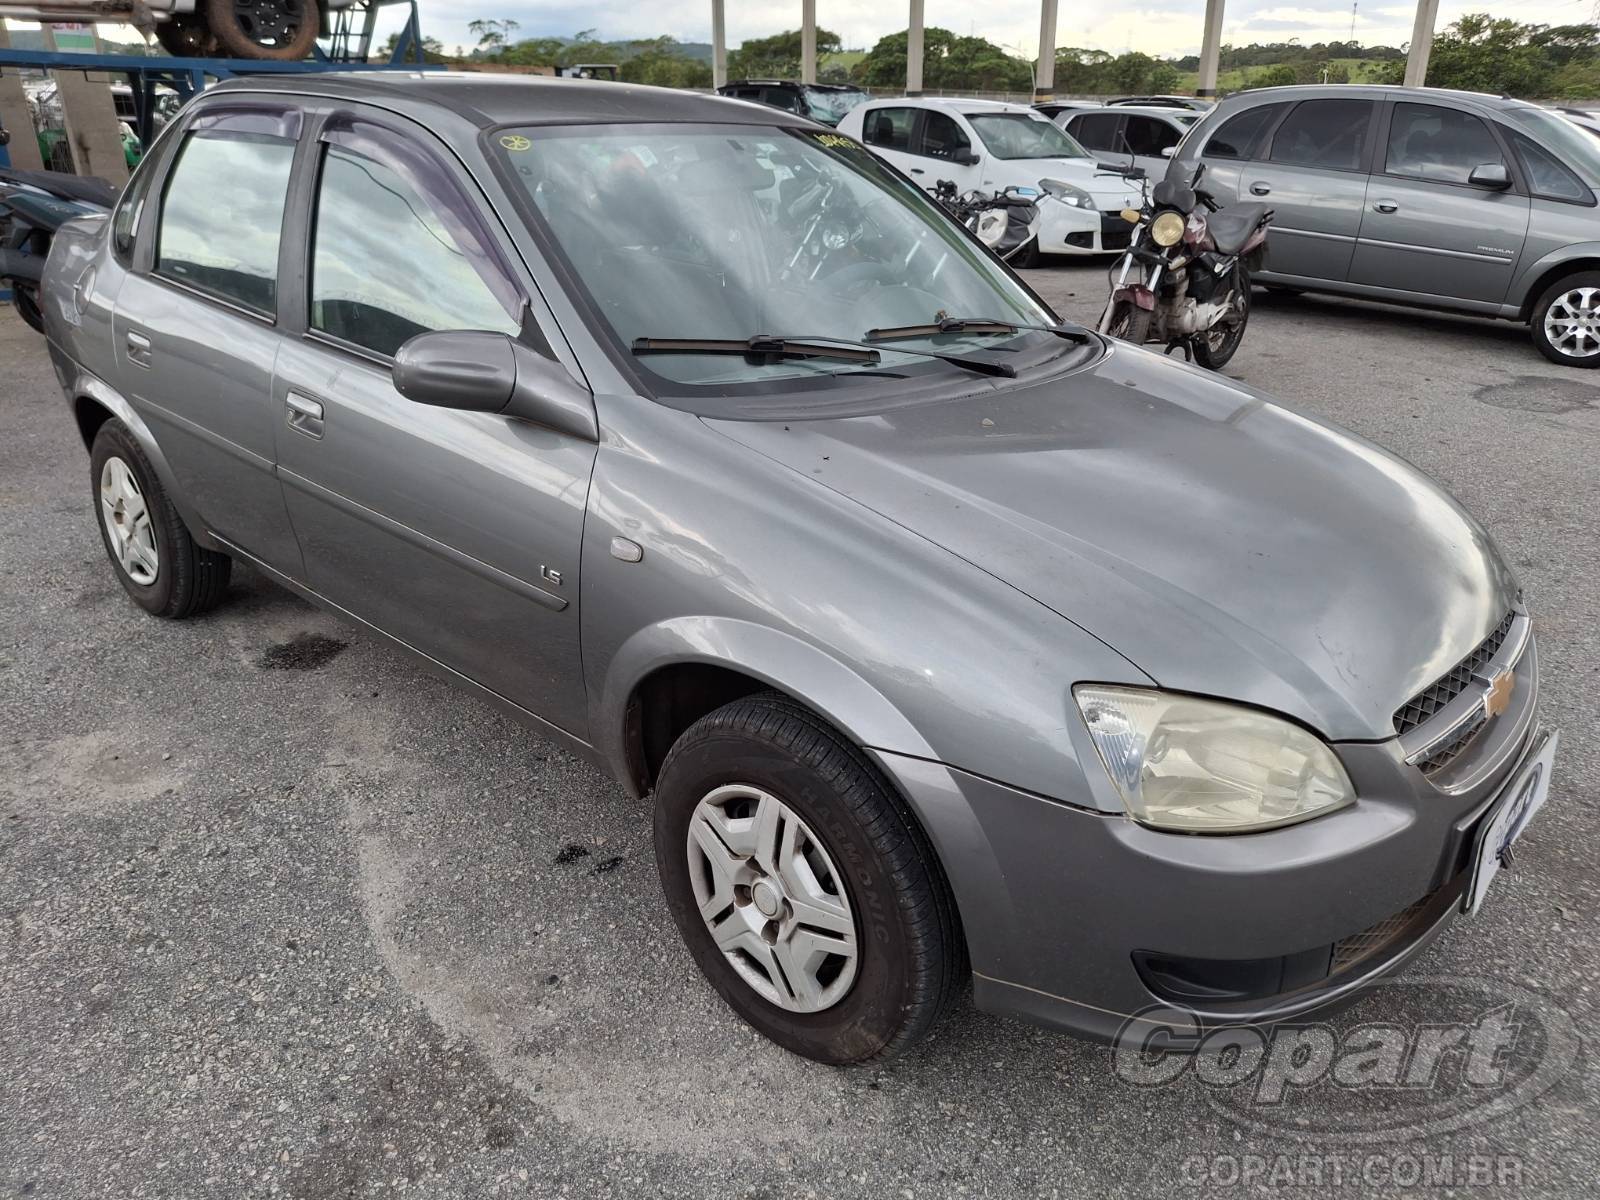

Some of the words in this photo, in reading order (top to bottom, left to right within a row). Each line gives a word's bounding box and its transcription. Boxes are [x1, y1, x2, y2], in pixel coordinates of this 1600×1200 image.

[1477, 245, 1515, 255] PREMIUM
[540, 565, 562, 585] LS
[800, 785, 890, 945] HARMONIC
